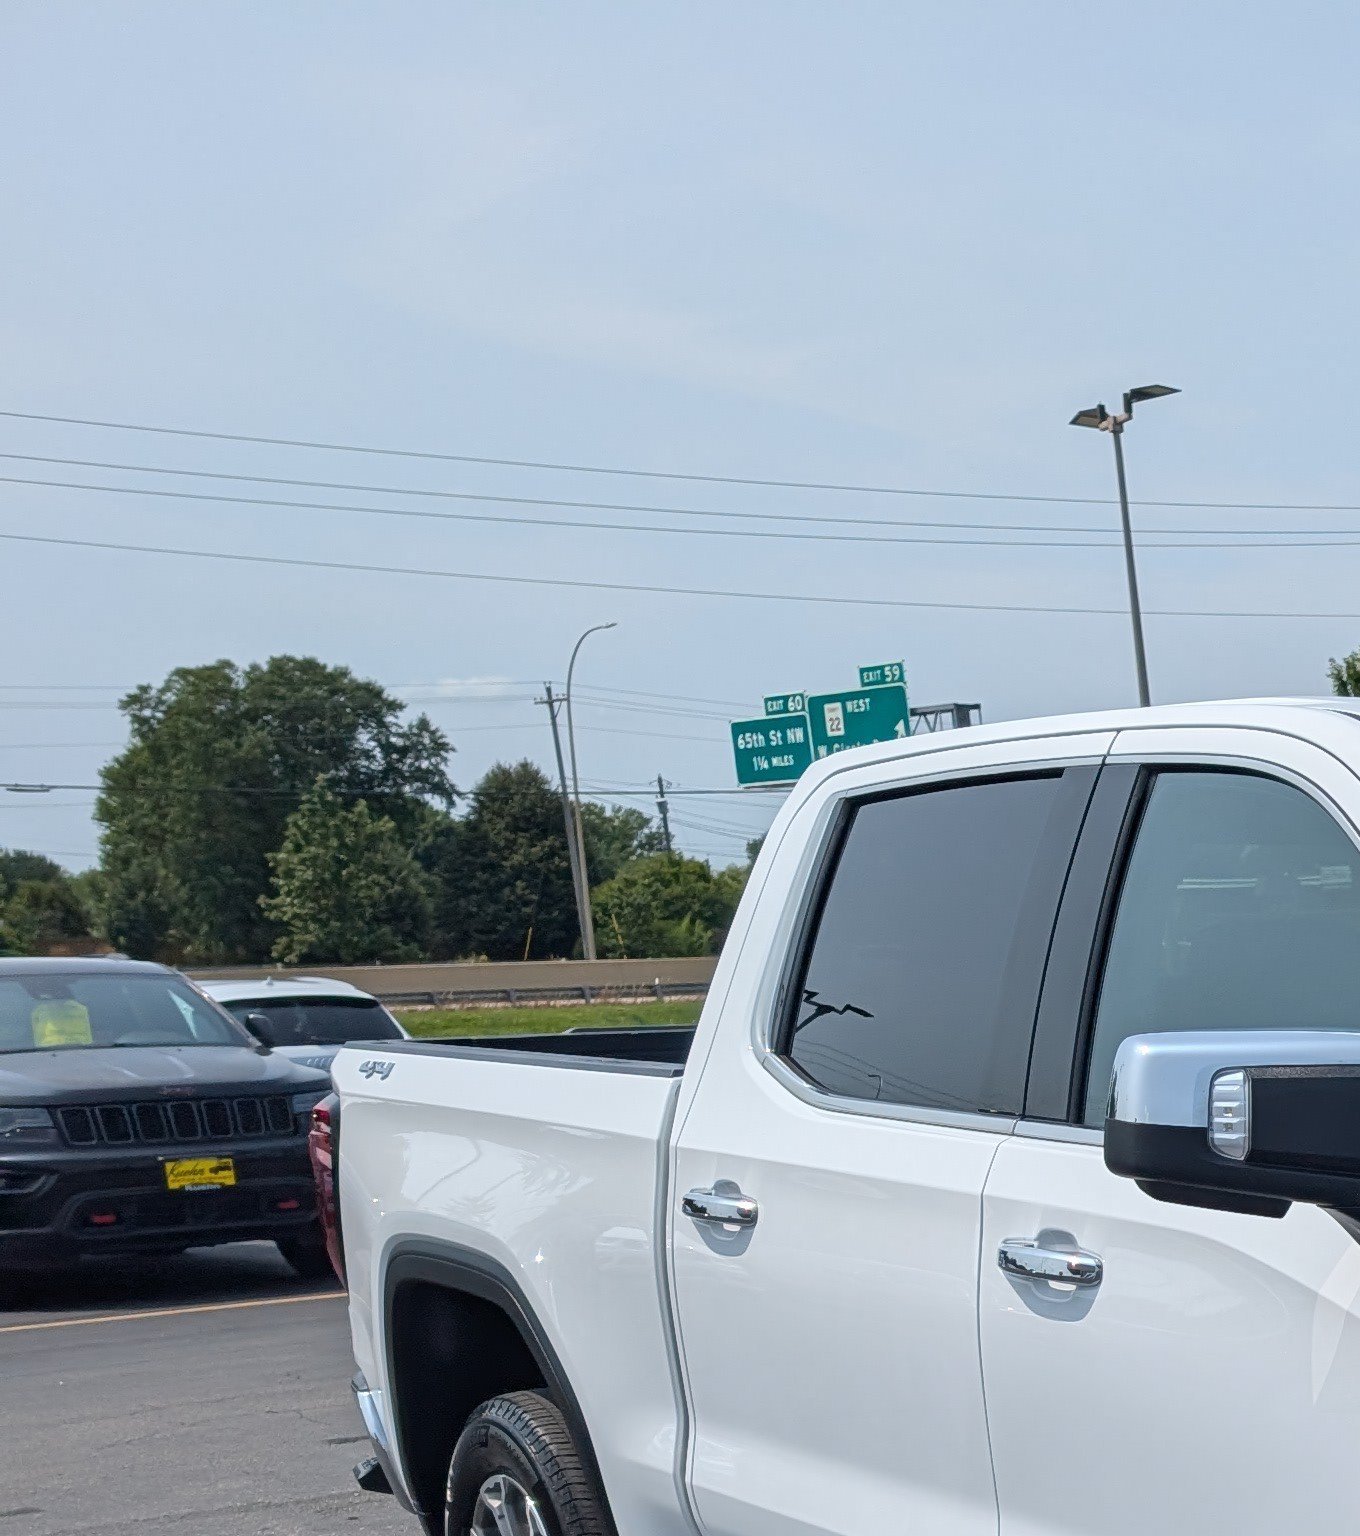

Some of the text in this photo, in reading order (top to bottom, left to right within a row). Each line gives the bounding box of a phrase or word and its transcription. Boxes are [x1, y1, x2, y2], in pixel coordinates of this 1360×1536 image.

[862, 665, 900, 683] EXIT 59
[766, 695, 803, 712] EXIT 60
[845, 698, 870, 713] WEST
[828, 717, 841, 732] 22
[737, 727, 804, 749] 65th St NW
[771, 755, 795, 767] MILES
